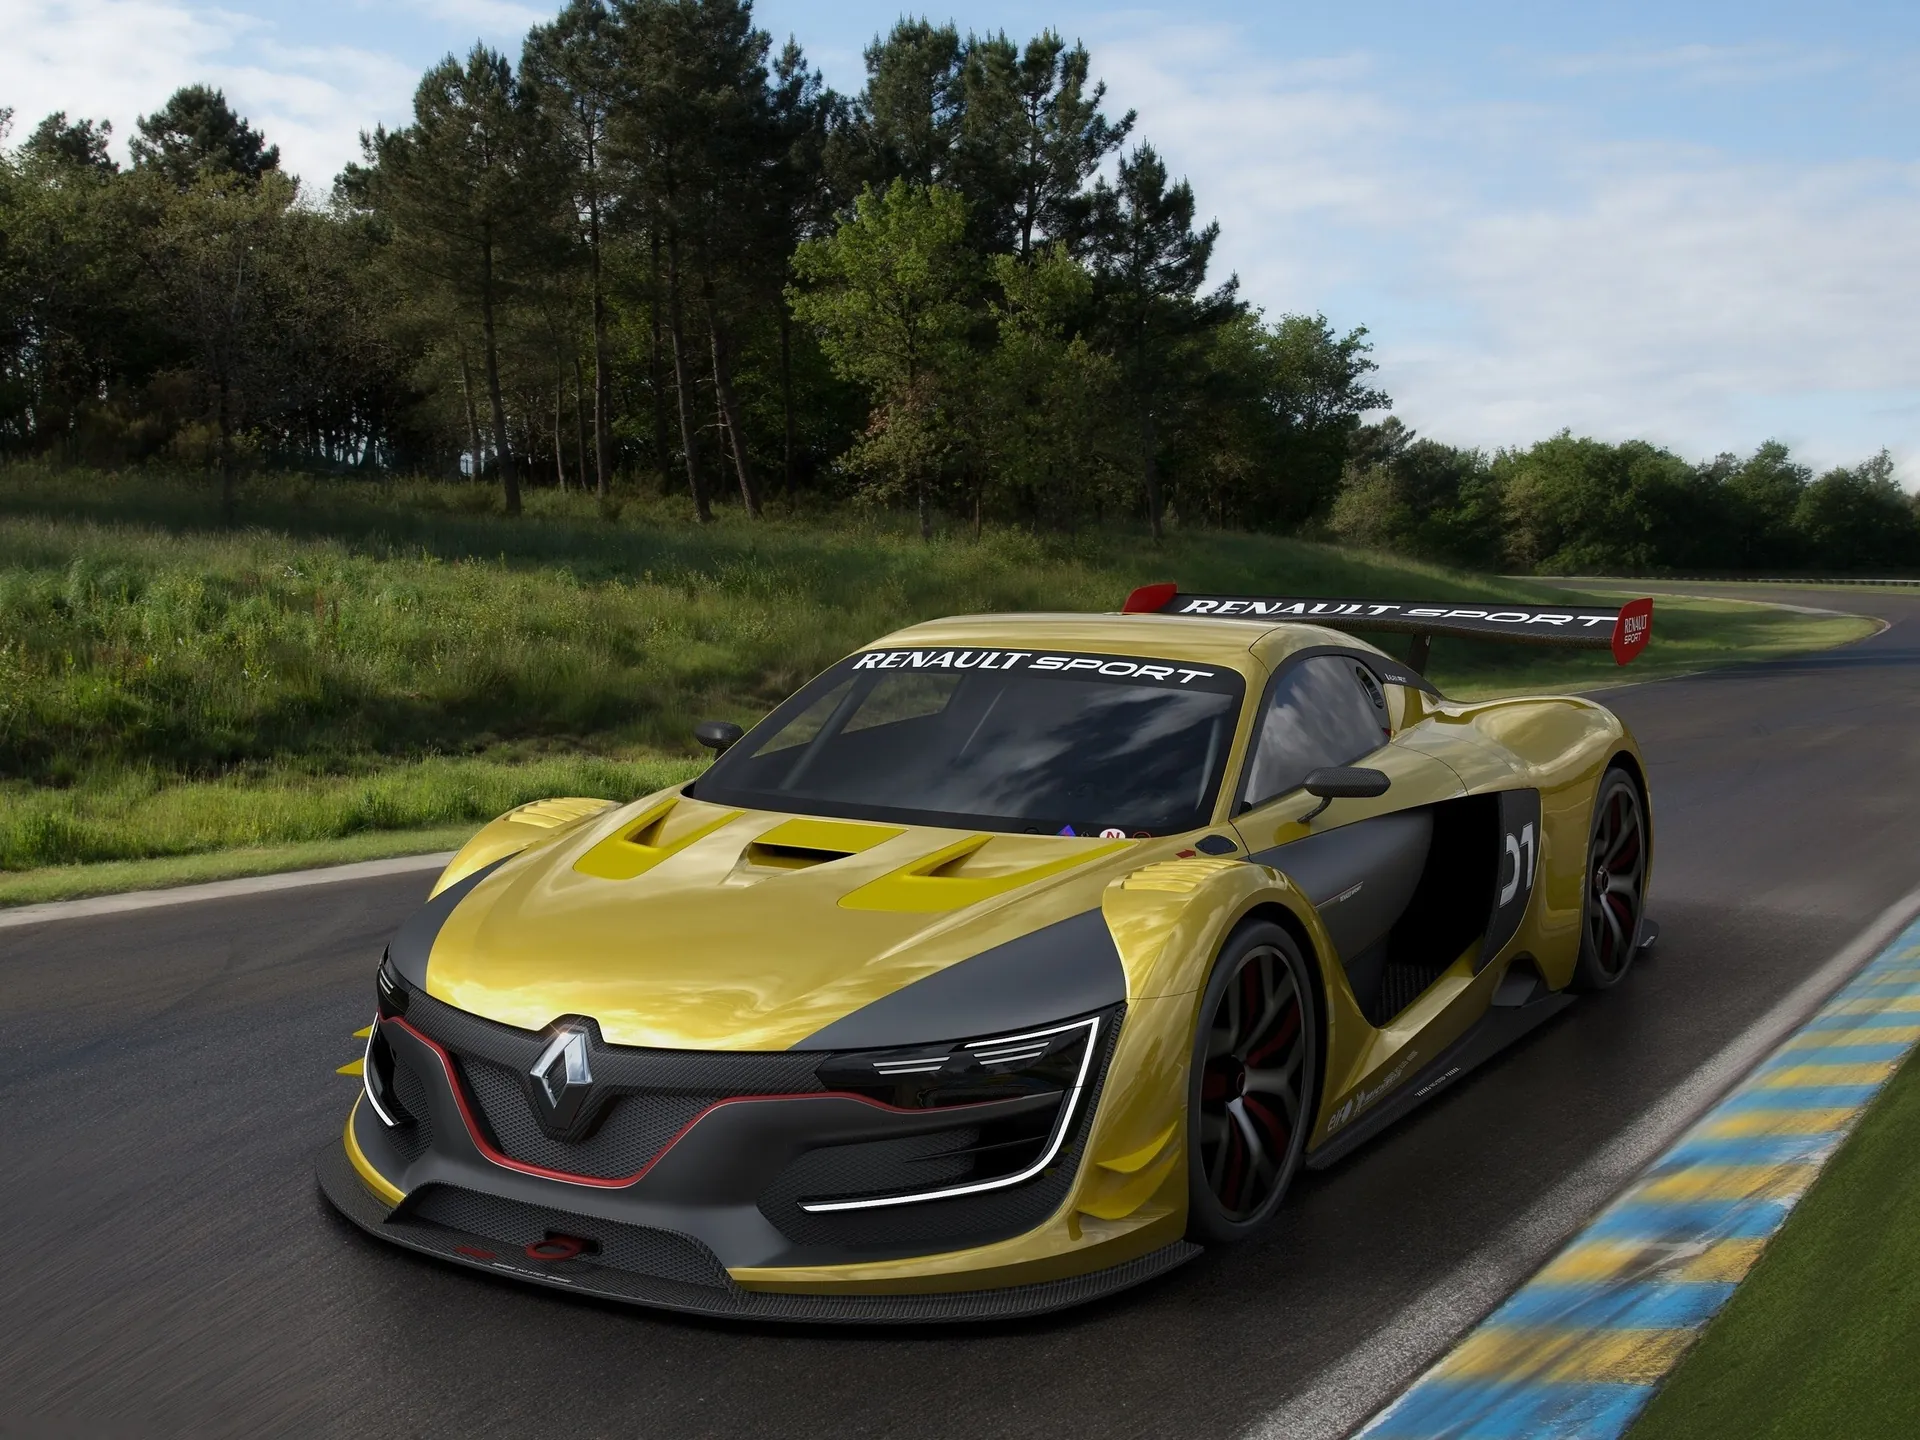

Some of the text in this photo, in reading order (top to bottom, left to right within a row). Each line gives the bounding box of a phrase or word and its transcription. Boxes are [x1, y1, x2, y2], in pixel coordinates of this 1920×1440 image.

[1178, 599, 1619, 627] RENAULT SPORT
[1624, 614, 1648, 633] RENAULT
[1624, 632, 1642, 645] SPORT
[851, 651, 1215, 684] RENAULT SPORT
